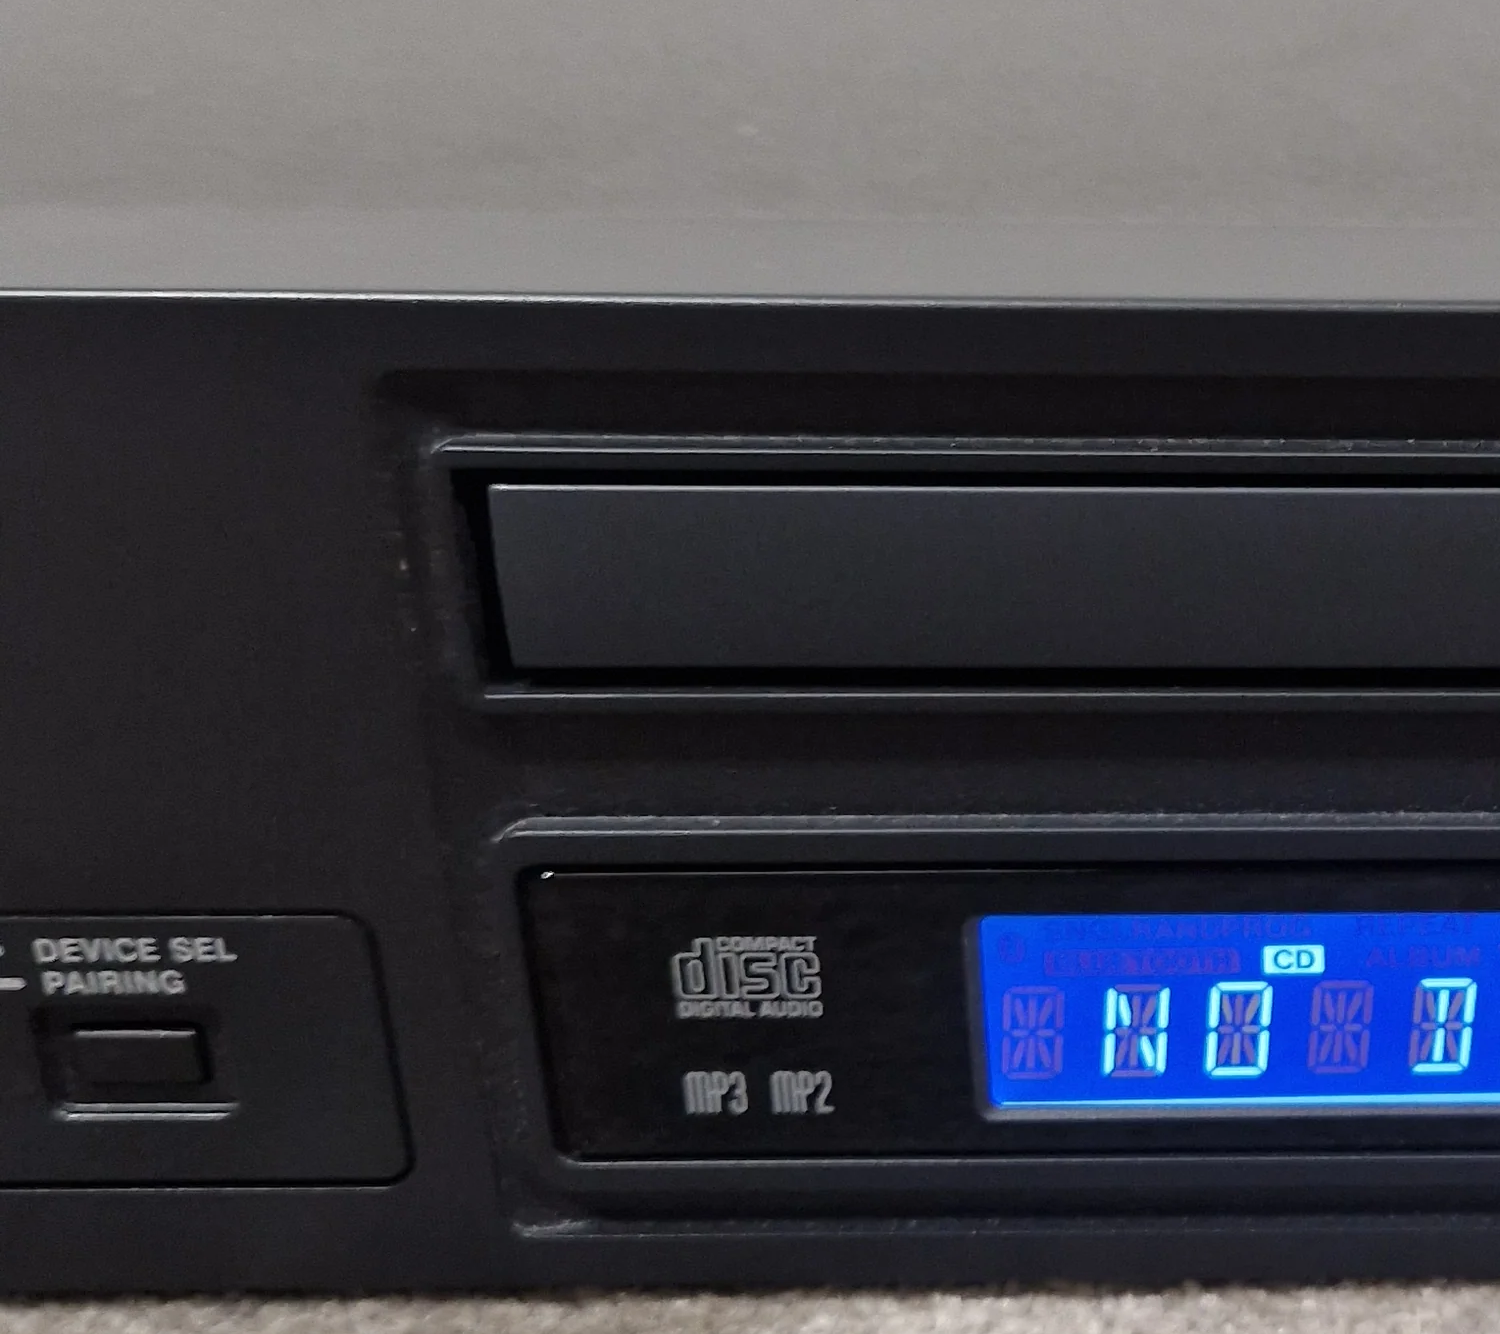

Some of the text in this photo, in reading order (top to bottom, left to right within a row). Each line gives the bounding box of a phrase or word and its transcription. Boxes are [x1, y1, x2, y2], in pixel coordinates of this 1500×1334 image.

[32, 937, 238, 964] DEVICE SEL
[715, 936, 817, 951] COMPACT
[1273, 948, 1316, 970] CD
[41, 970, 187, 996] PAIRING
[677, 1000, 823, 1019] DIGITAL AUDIO
[1103, 981, 1274, 1077] NO
[683, 1071, 749, 1115] MP3
[770, 1070, 835, 1114] MP2
